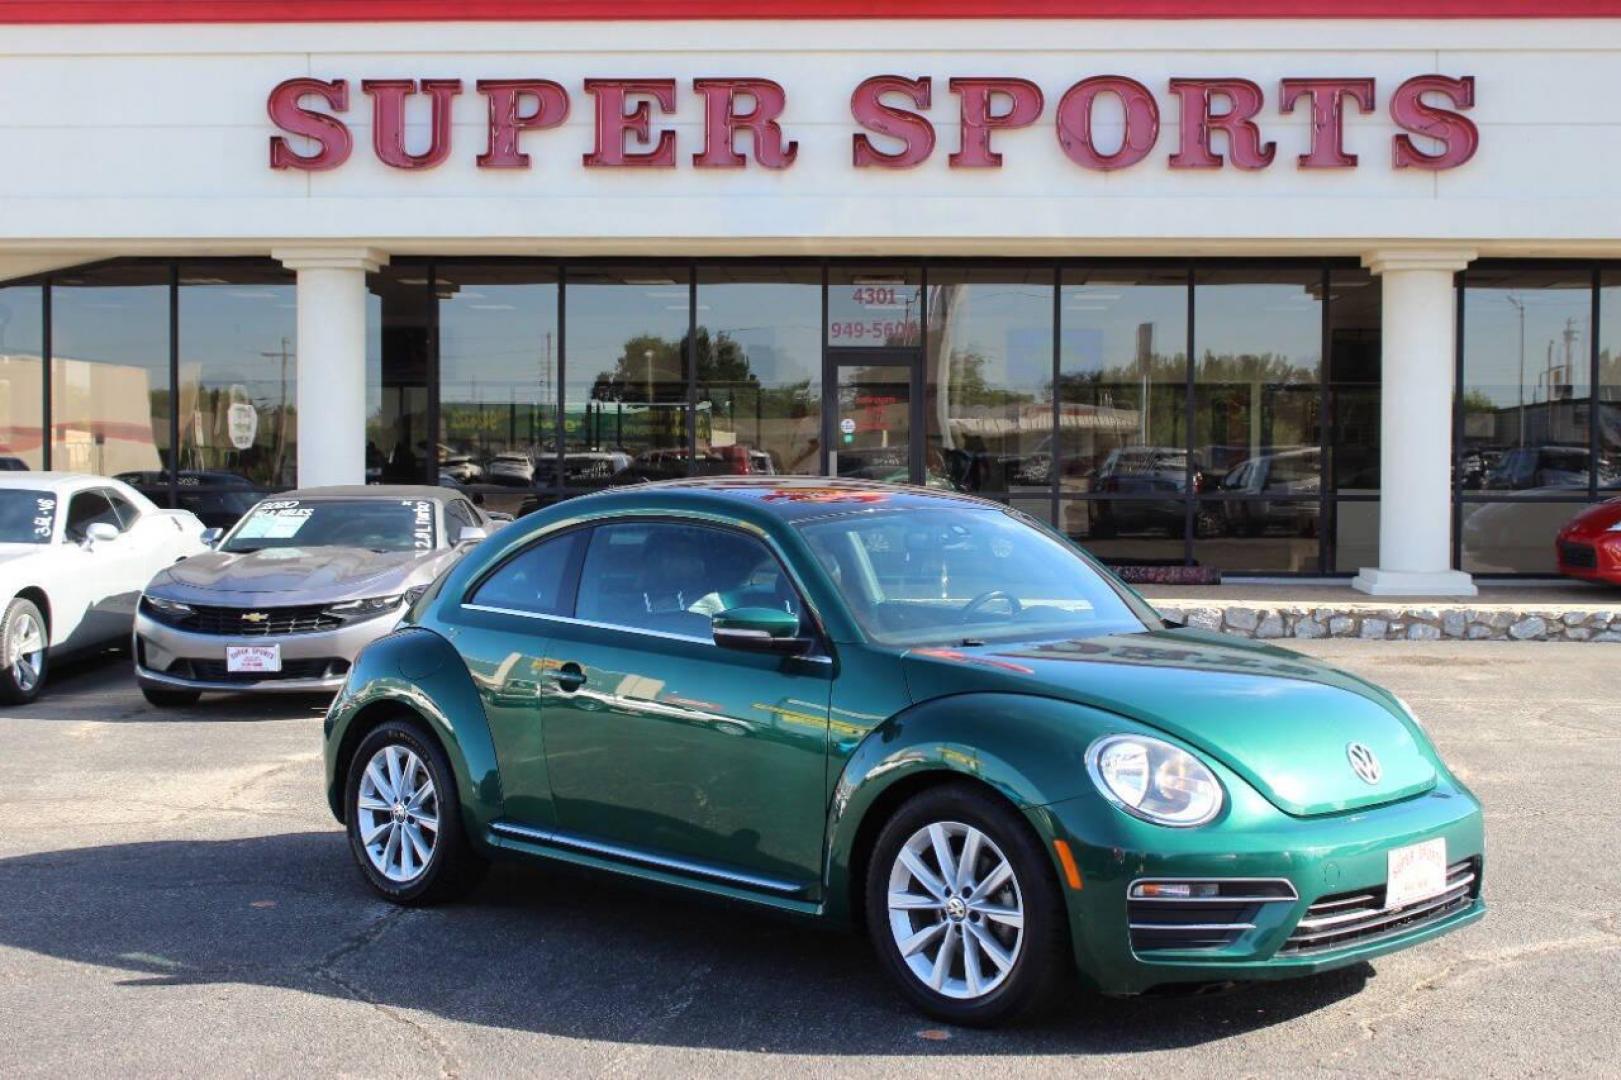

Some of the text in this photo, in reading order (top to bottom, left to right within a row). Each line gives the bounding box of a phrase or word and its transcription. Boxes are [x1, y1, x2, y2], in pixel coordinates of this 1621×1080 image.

[267, 74, 1478, 170] SUPER SPORTS
[853, 287, 896, 304] 4301
